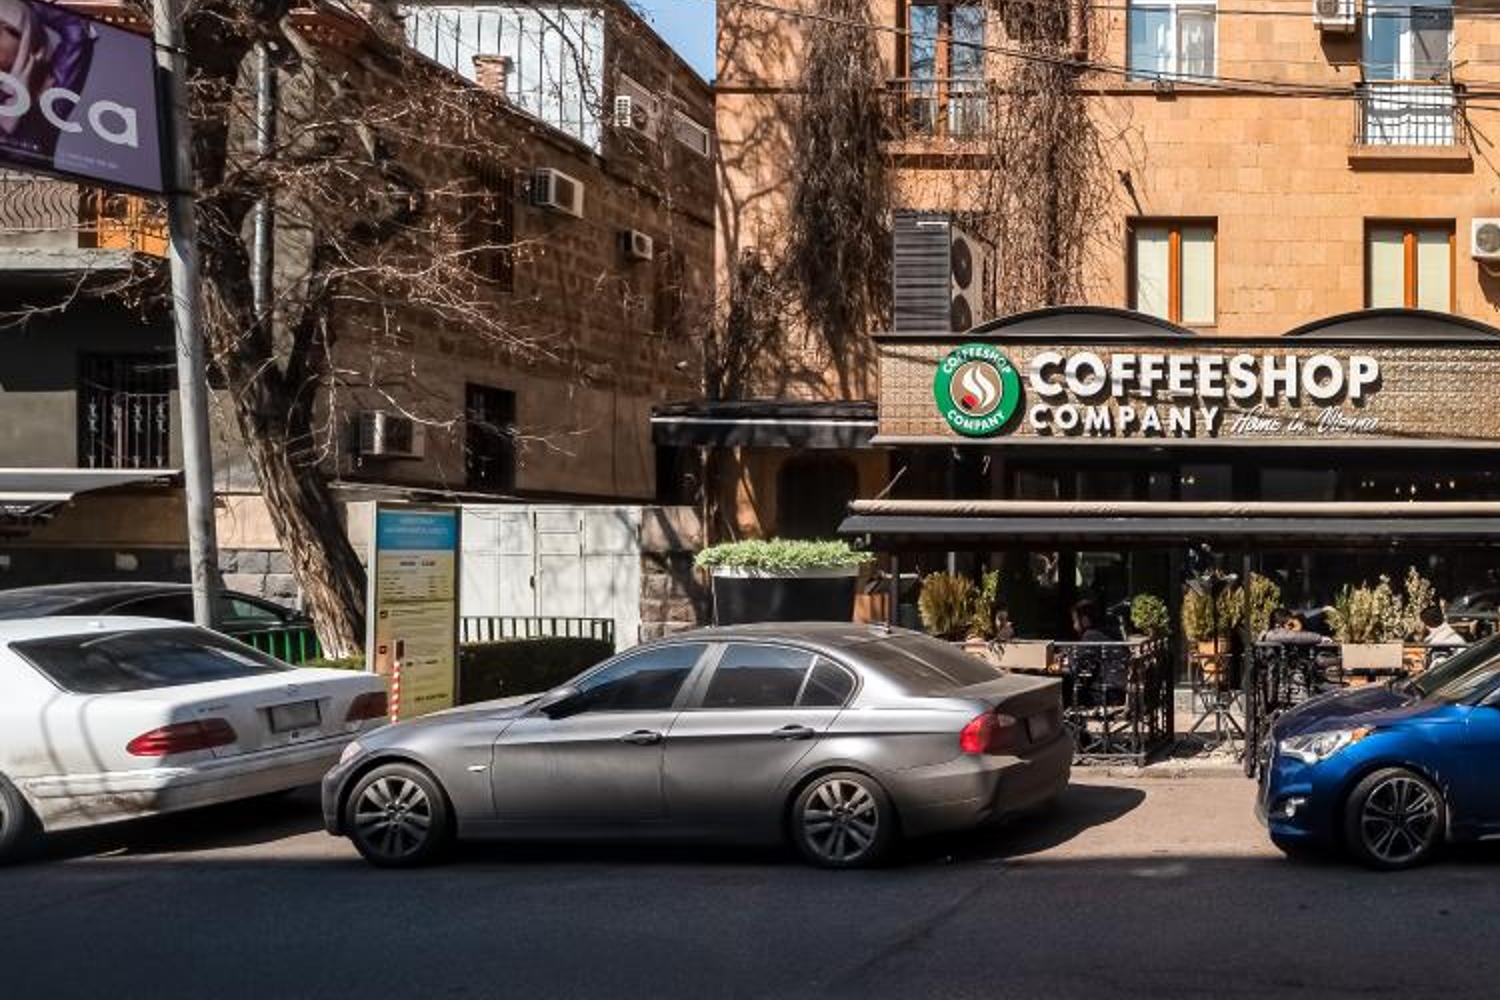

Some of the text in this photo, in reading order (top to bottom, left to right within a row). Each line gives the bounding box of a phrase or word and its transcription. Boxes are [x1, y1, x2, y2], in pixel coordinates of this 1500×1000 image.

[943, 347, 1011, 374] COFFEESHOP
[1029, 352, 1380, 399] COFFEESHOP
[947, 409, 1005, 431] COMPANY
[1029, 402, 1379, 434] COMPANY Home in Vienna
